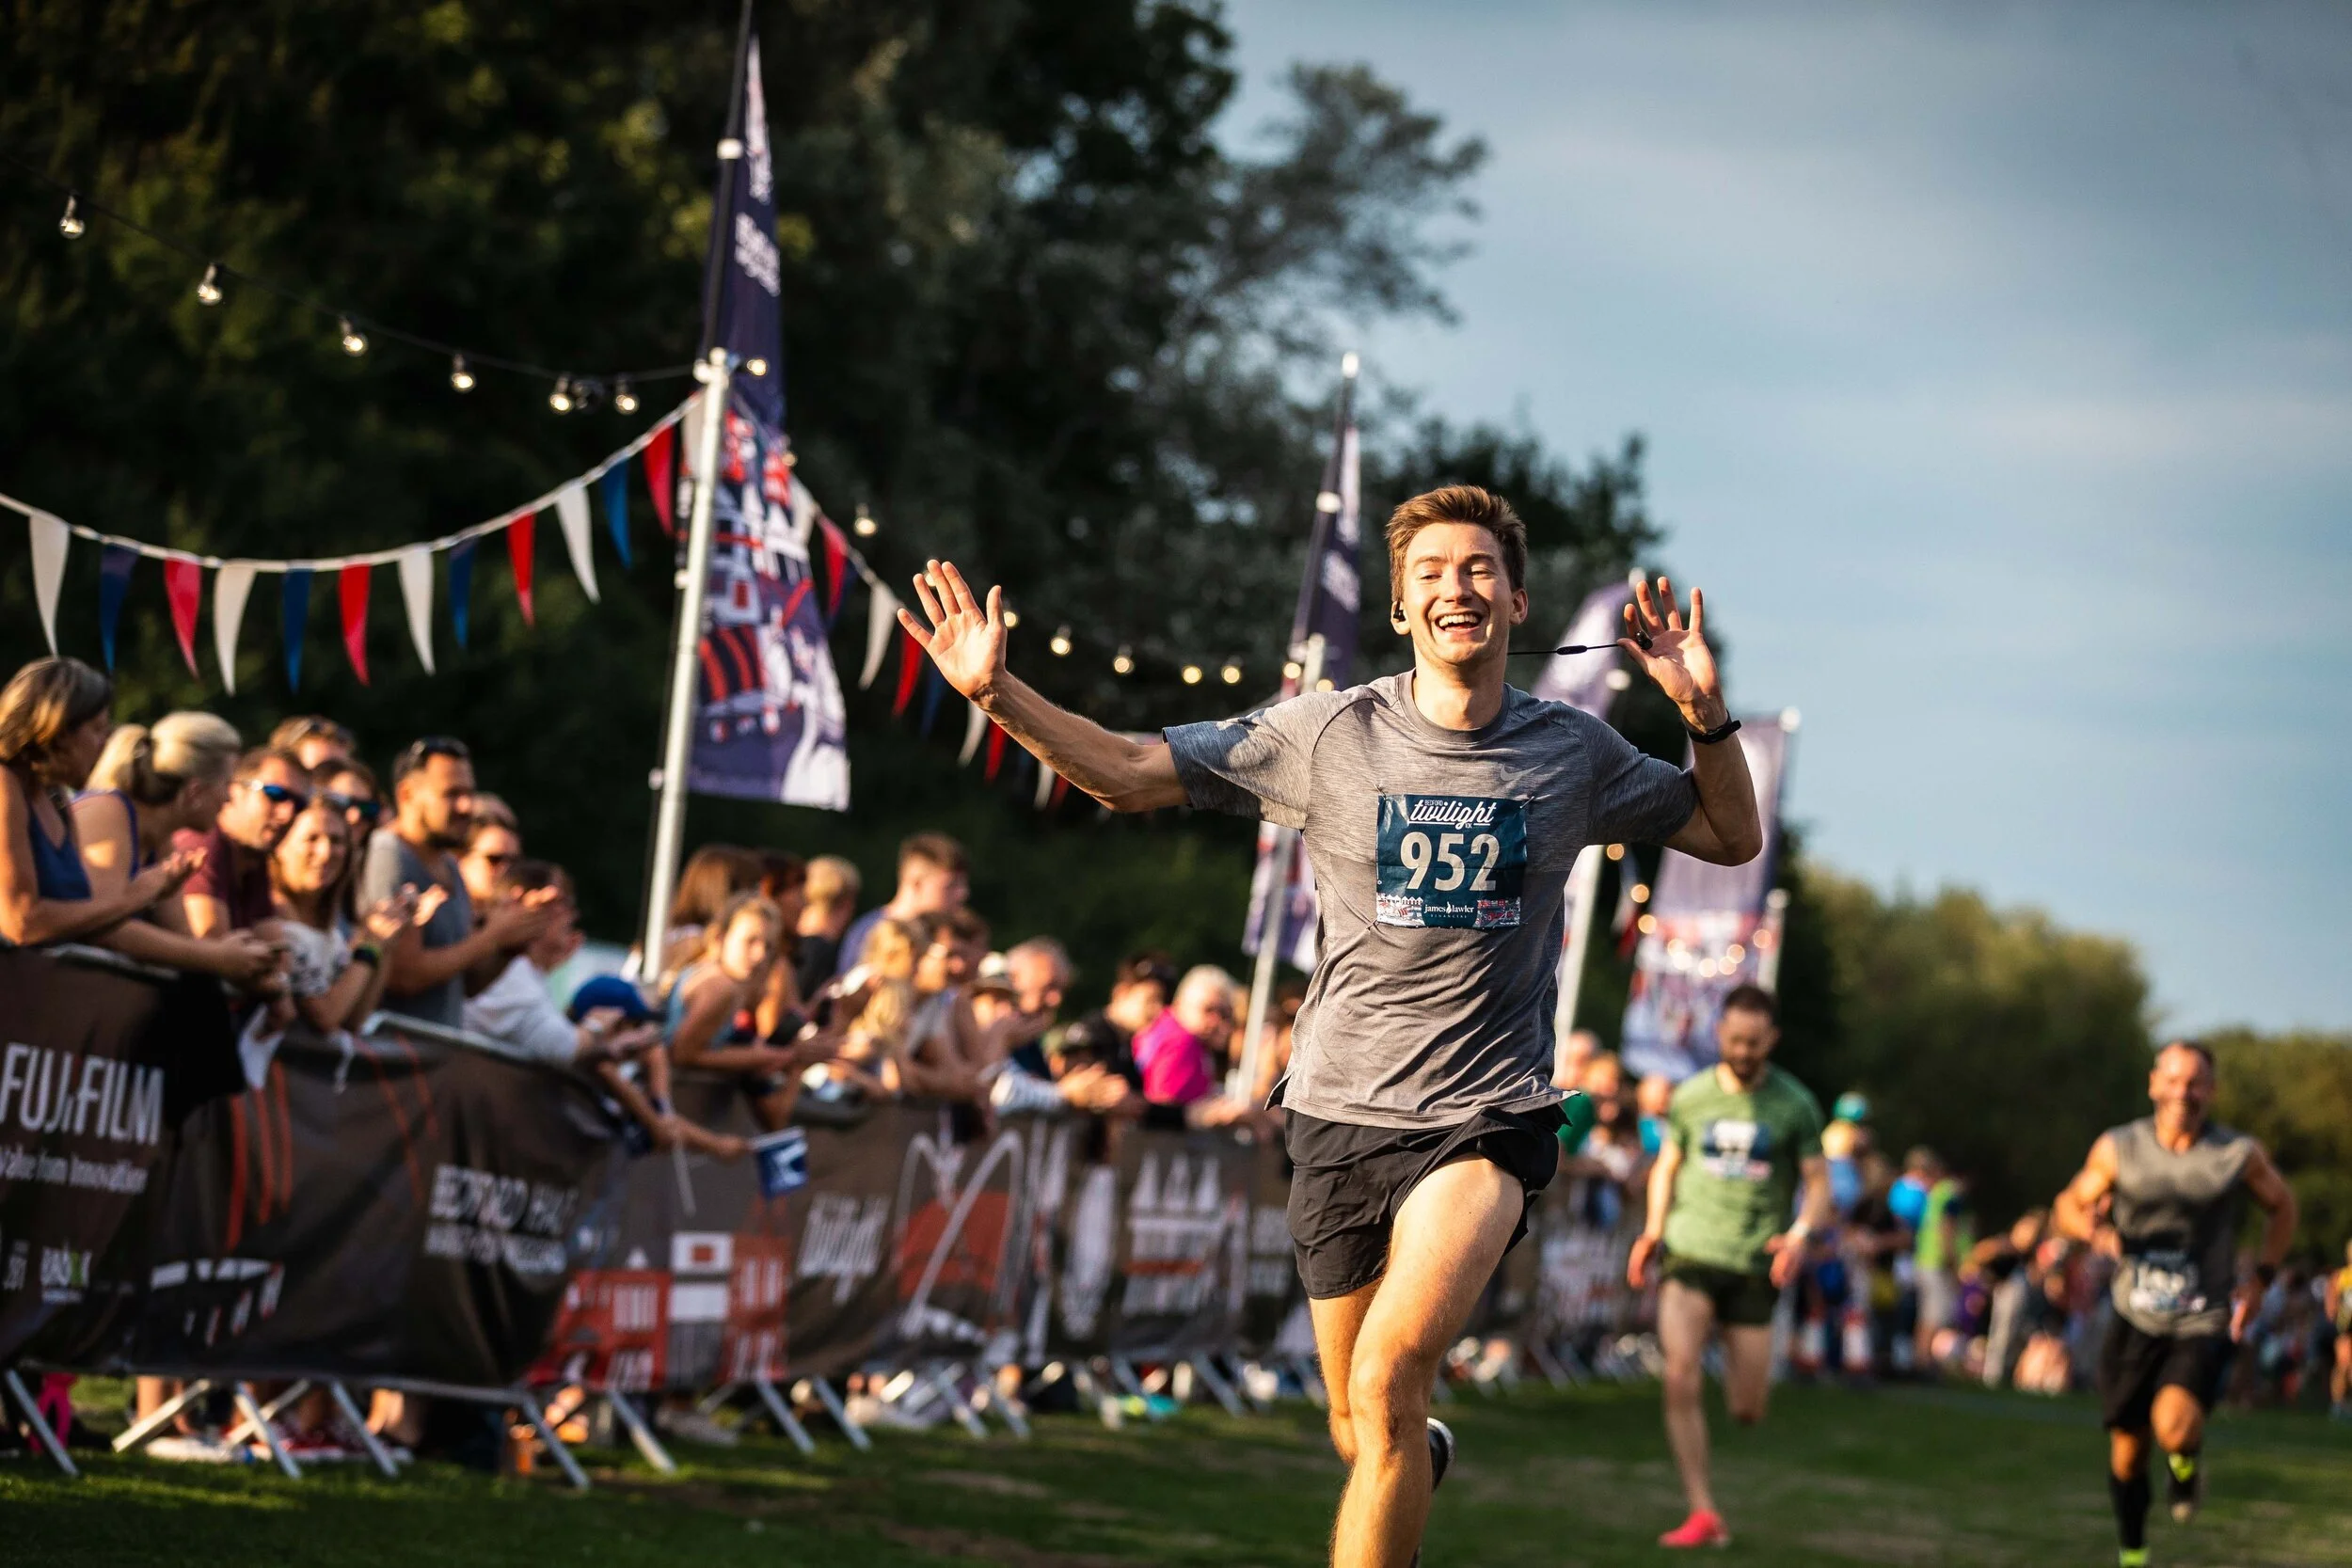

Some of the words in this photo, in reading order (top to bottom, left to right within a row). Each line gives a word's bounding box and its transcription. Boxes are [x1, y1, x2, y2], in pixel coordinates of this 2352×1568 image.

[1410, 800, 1497, 830] twilight
[1400, 832, 1500, 891] 952
[1423, 904, 1446, 913] james
[1452, 904, 1474, 913] lawler
[0, 1041, 165, 1147] FUJIFILM
